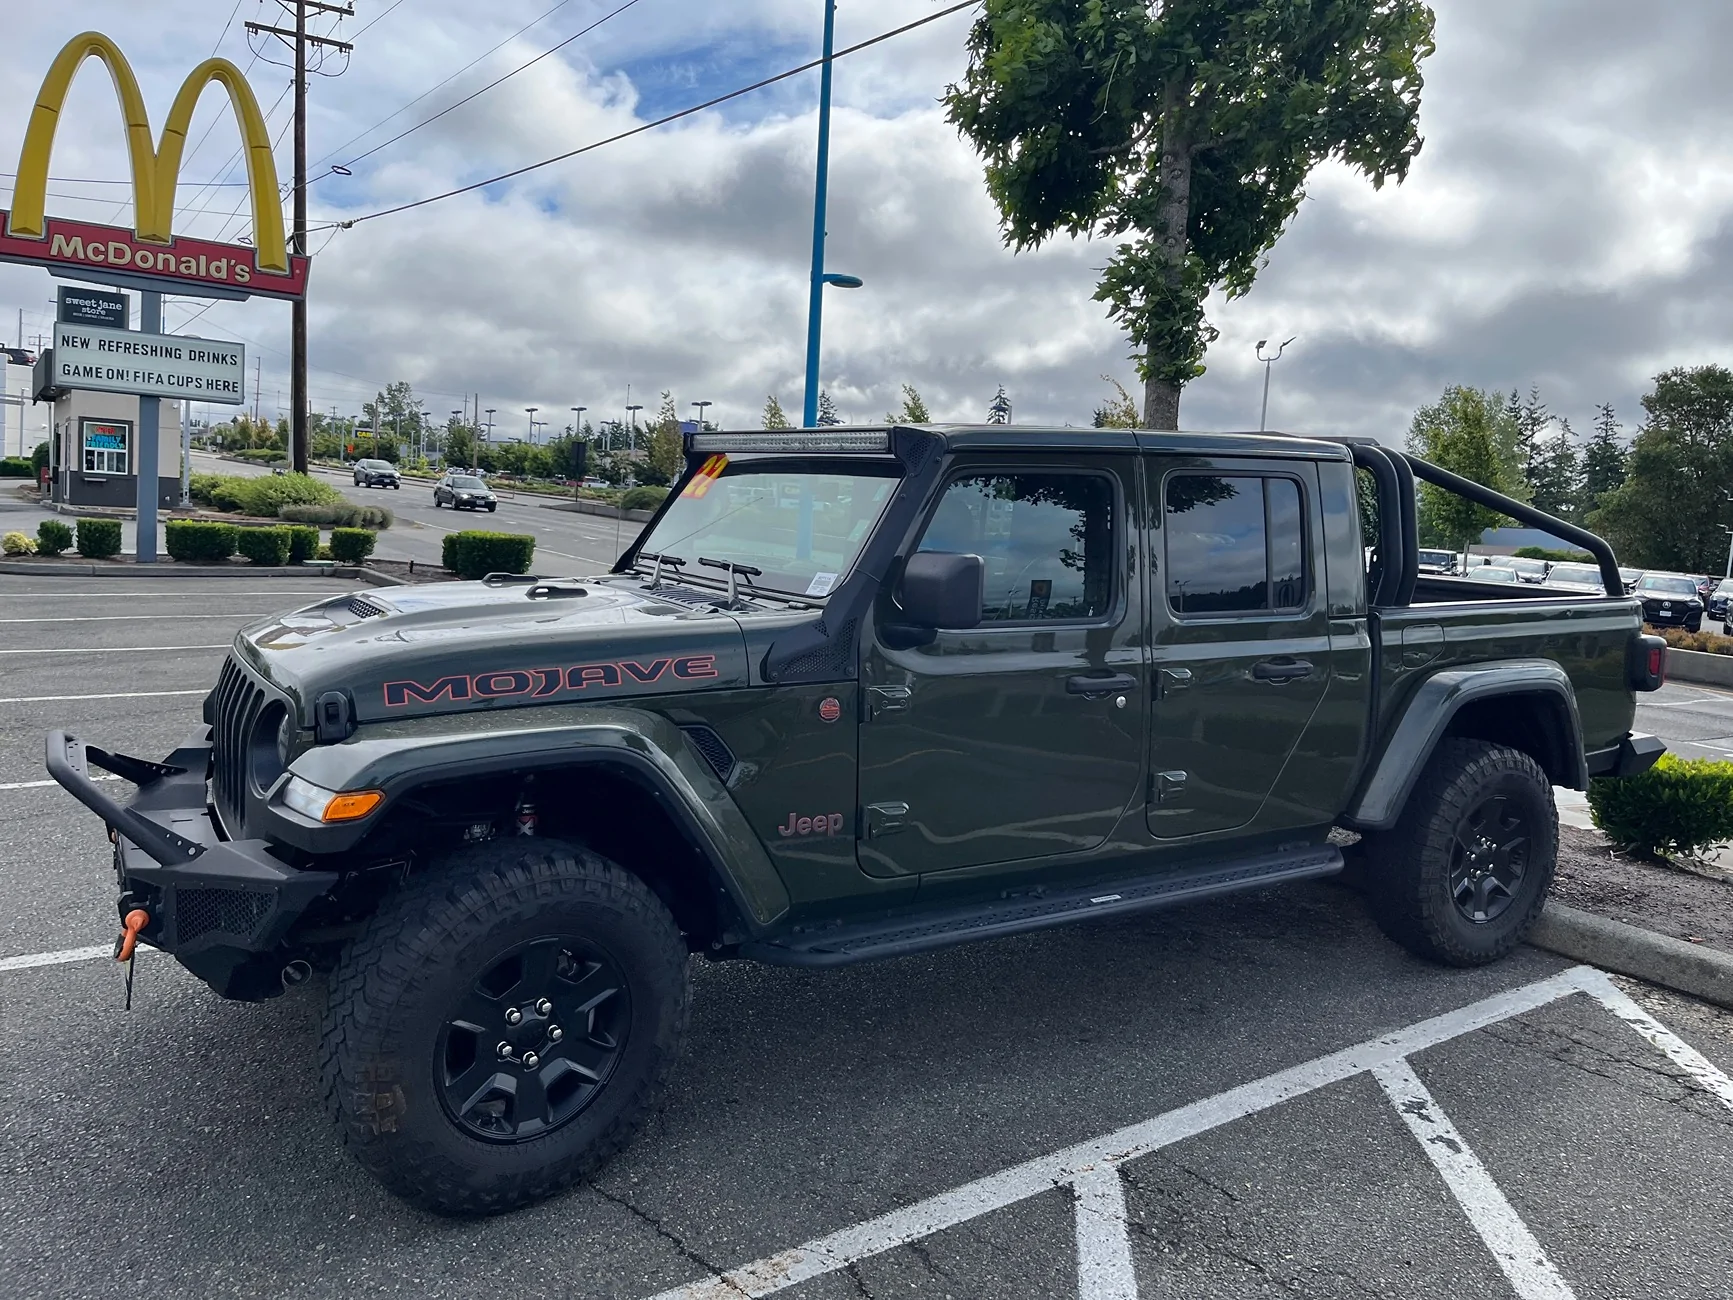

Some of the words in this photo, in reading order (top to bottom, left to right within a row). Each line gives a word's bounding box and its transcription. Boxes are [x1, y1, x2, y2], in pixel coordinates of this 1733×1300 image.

[50, 234, 251, 283] McDonald's
[65, 297, 97, 307] sweet
[98, 299, 122, 310] jane
[81, 307, 106, 315] store
[61, 335, 90, 349] NEW
[98, 339, 182, 360] REFRESHING
[188, 349, 238, 366] DRINKS
[62, 363, 102, 379] GAME
[106, 368, 129, 381] ON!
[133, 371, 164, 385] FIFA
[167, 374, 202, 389] CUPS
[206, 378, 239, 393] HERE
[682, 455, 729, 496] 22
[384, 655, 718, 707] MOJAVE
[778, 812, 844, 837] Jeep
